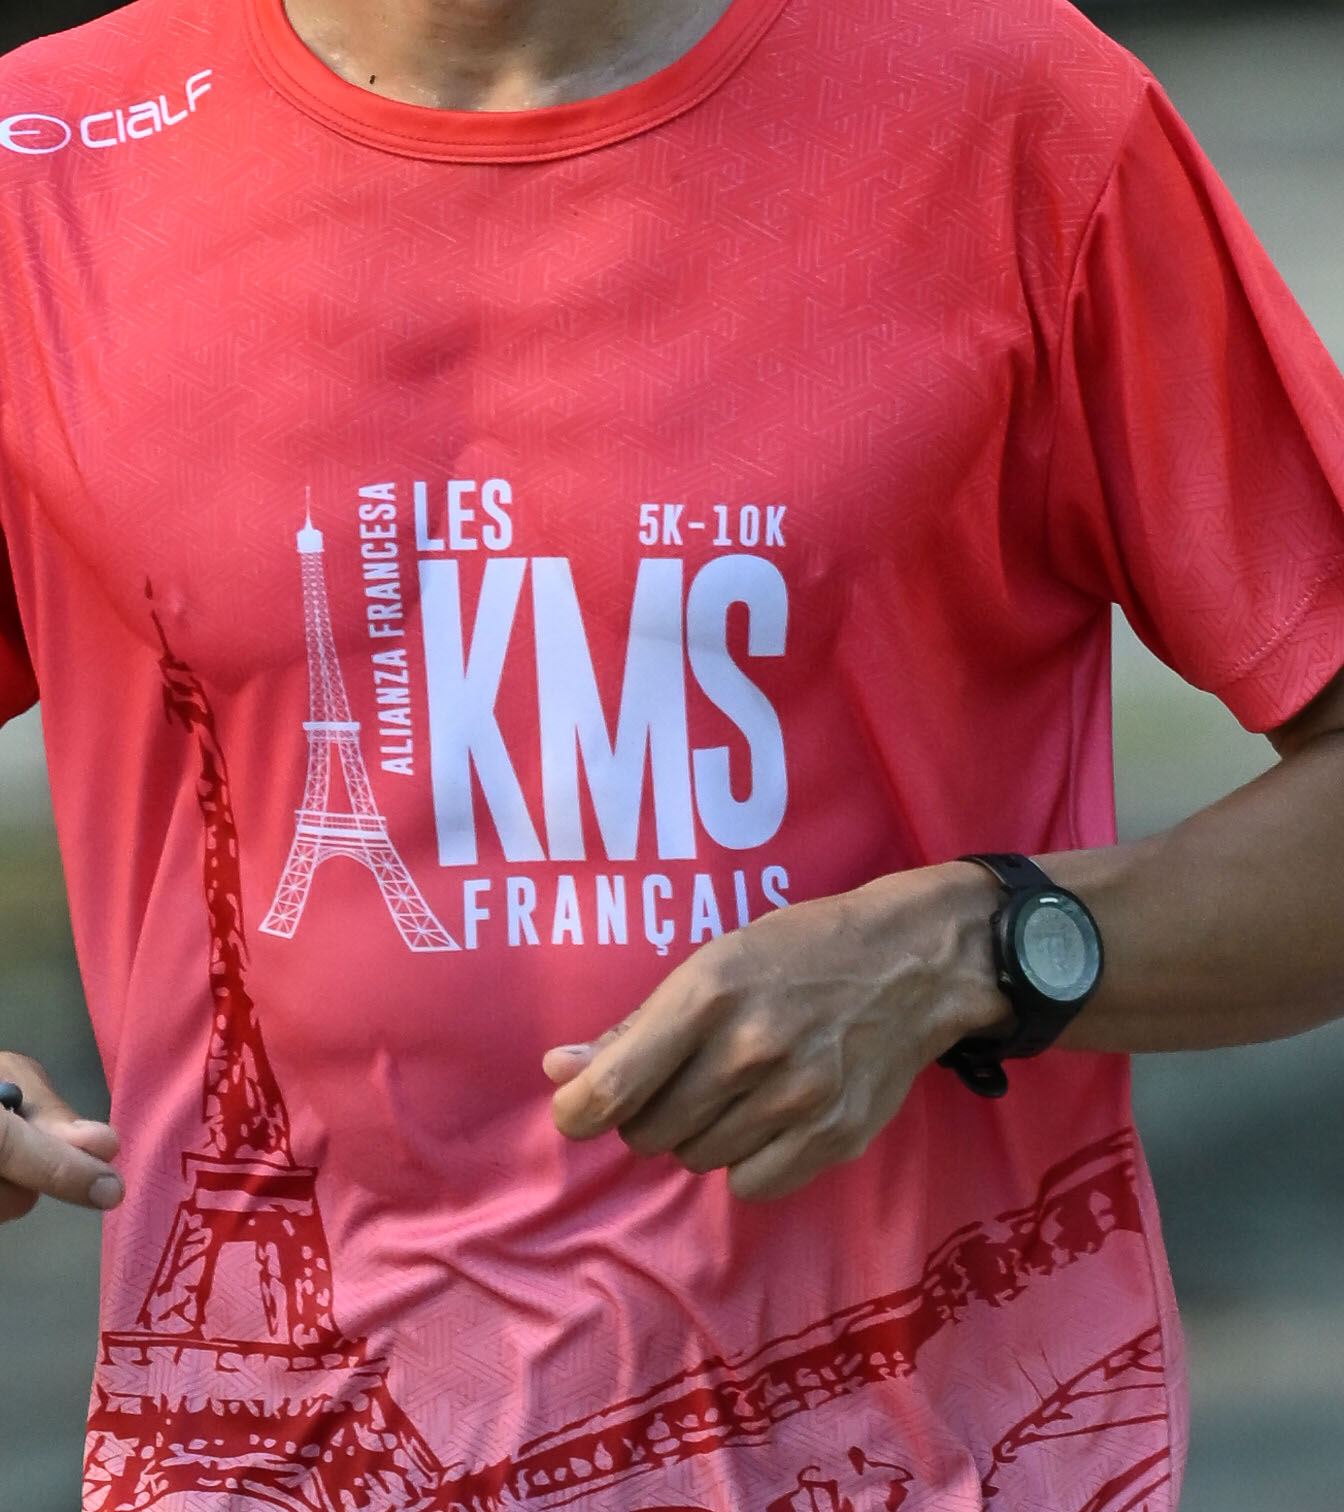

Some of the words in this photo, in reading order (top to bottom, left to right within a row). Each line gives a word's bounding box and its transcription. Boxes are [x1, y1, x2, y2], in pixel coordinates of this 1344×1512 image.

[358, 482, 404, 637] FRANCESA
[414, 478, 513, 551] LES
[639, 503, 787, 546] 5K-10K
[370, 648, 414, 776] ALIANZA
[418, 554, 789, 866] KMS
